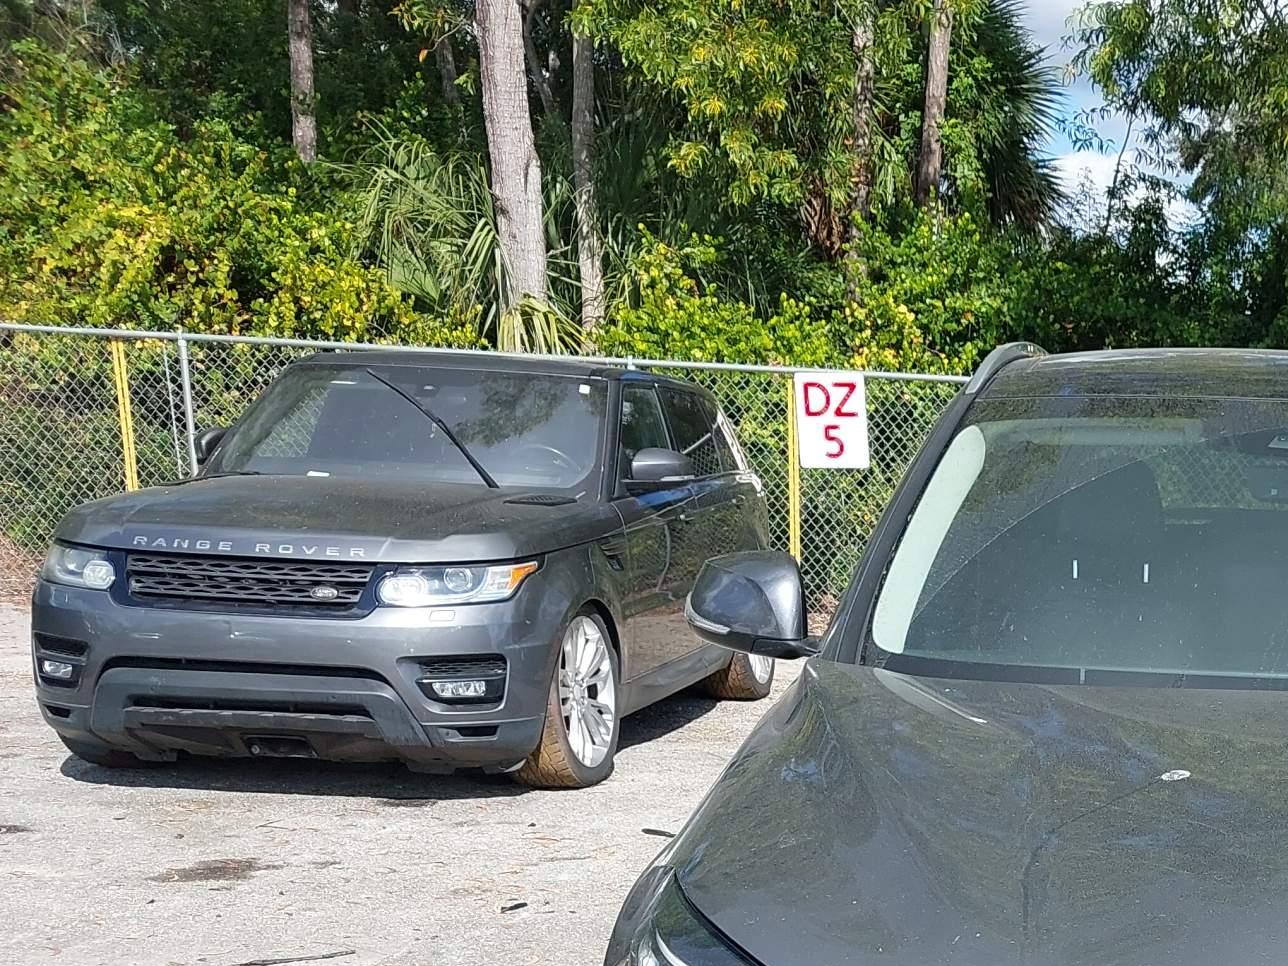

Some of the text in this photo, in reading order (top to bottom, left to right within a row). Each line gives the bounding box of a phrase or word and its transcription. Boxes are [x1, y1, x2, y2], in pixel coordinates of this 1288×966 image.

[803, 381, 859, 418] DZ
[824, 424, 845, 459] 5
[132, 535, 366, 558] RANGE ROVER
